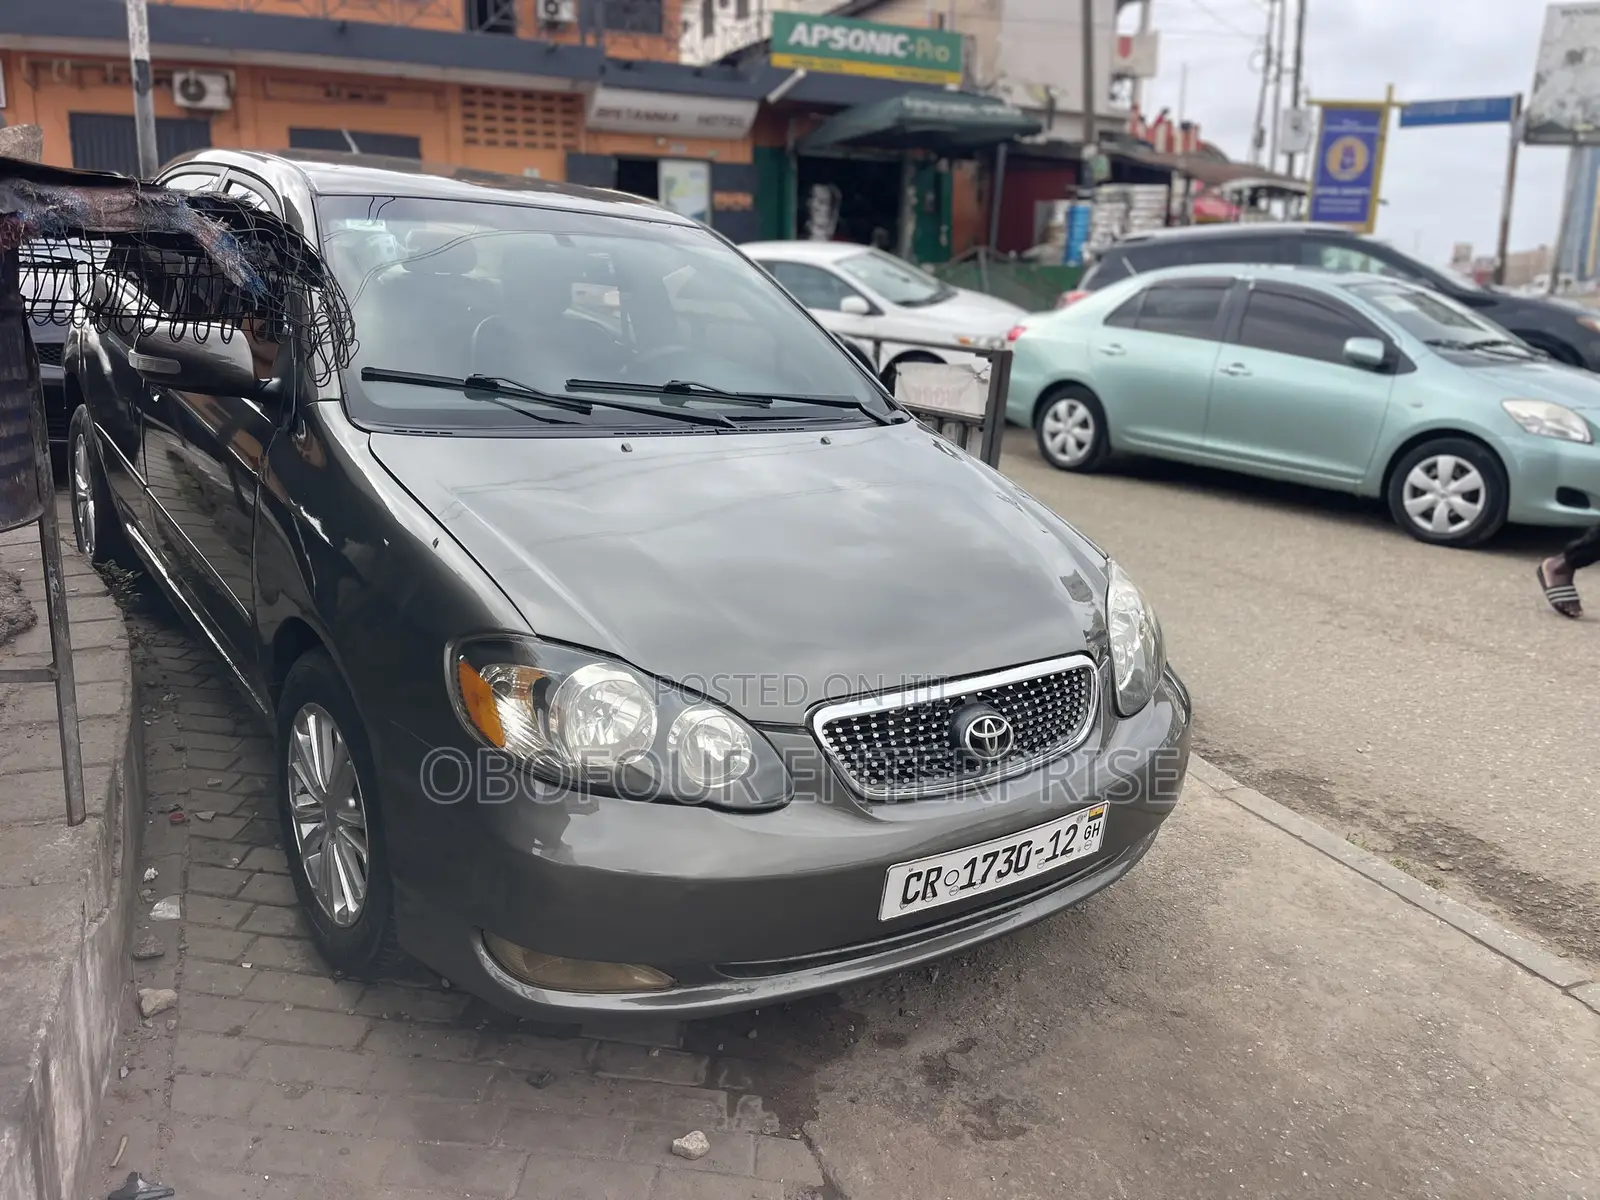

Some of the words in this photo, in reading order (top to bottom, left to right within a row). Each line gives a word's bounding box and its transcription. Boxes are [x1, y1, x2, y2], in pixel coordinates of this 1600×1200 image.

[1084, 821, 1101, 840] GH
[901, 866, 942, 905] CR
[959, 823, 1078, 891] 1730-12
